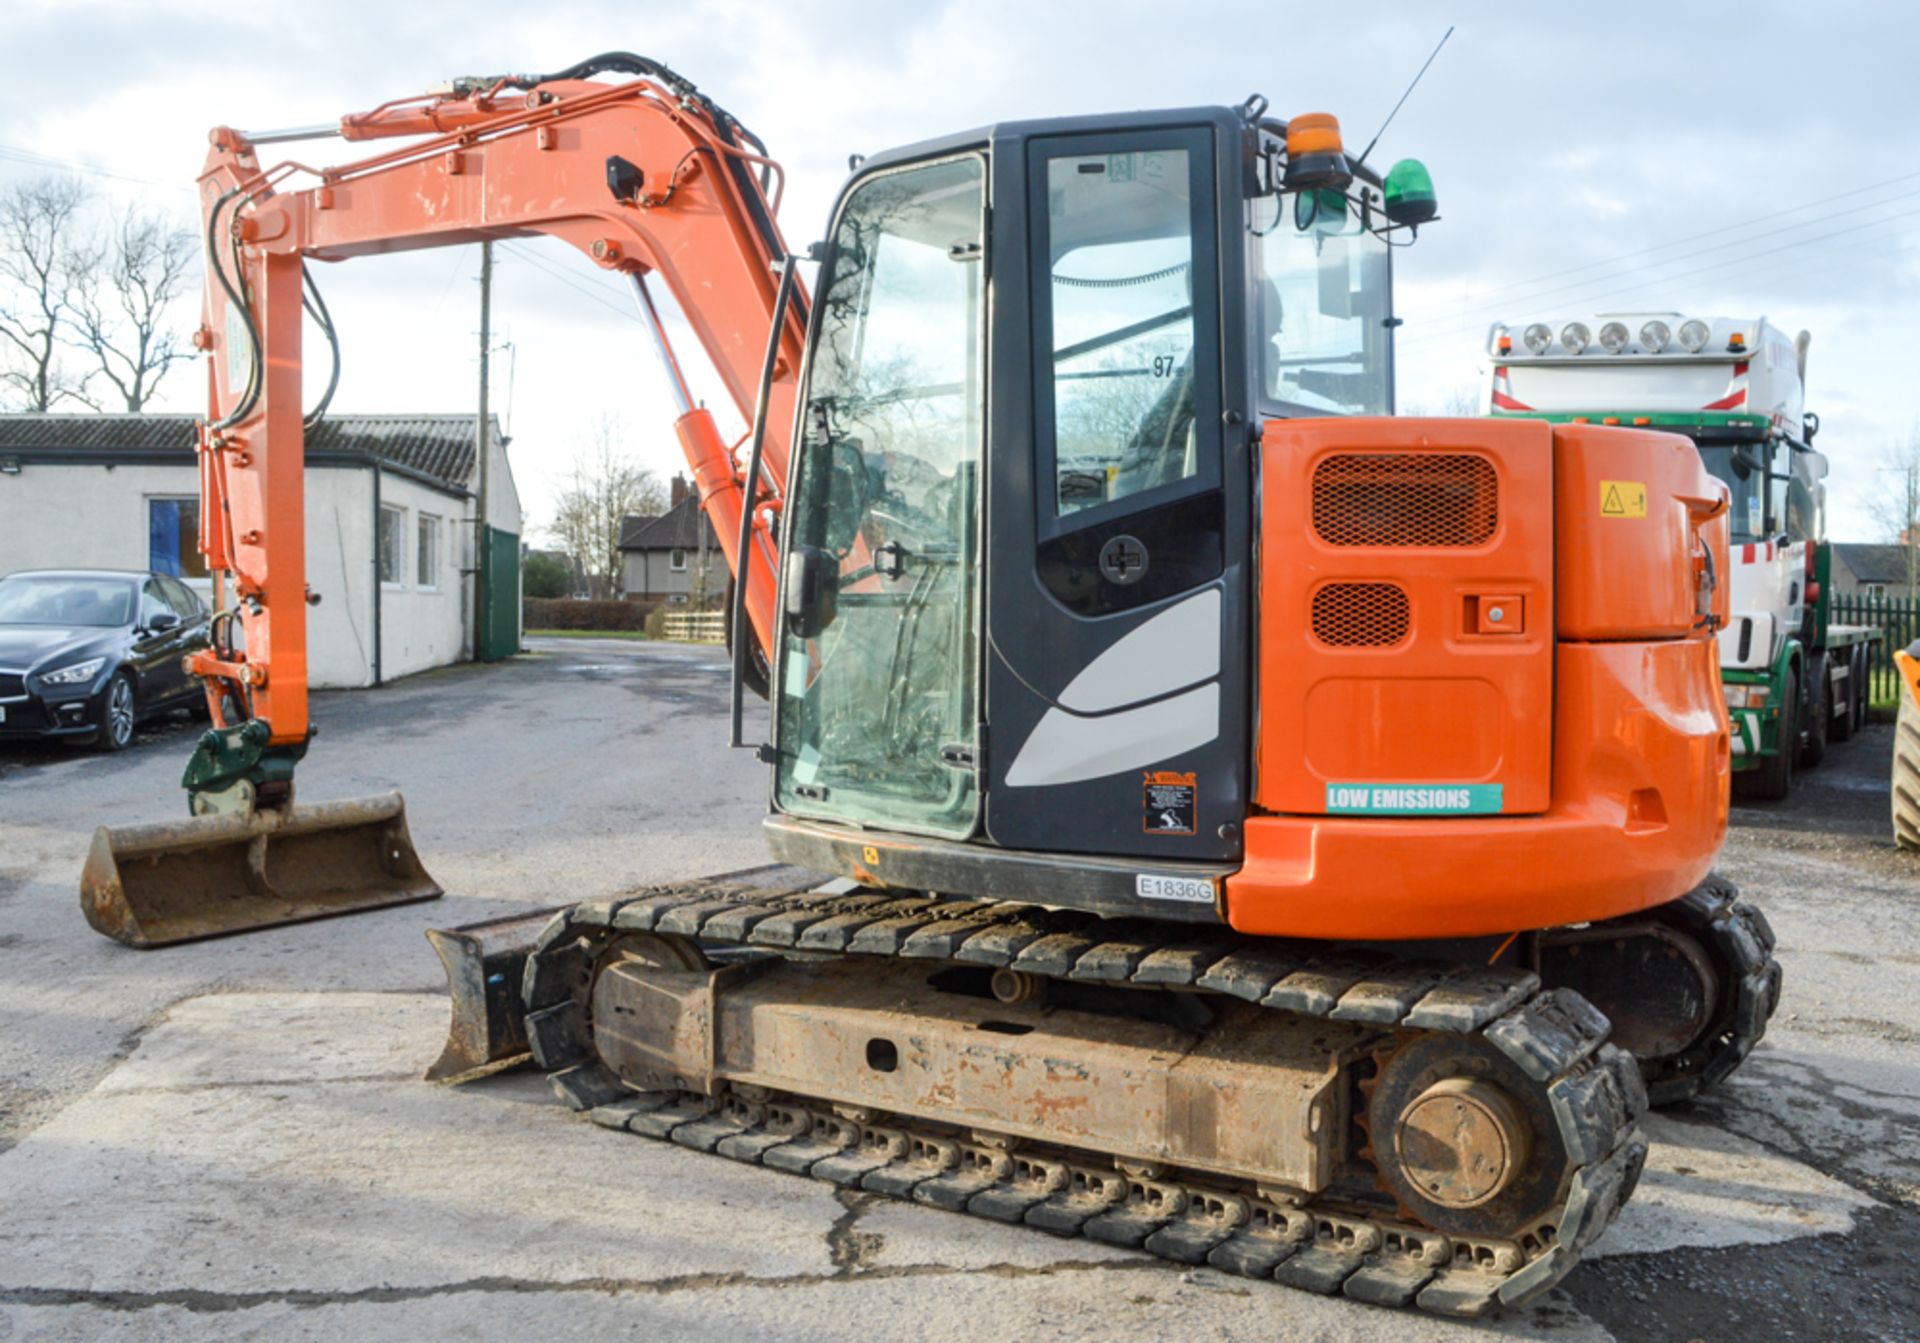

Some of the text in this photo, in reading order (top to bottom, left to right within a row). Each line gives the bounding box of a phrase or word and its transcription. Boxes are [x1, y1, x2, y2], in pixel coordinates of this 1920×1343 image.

[1154, 356, 1174, 378] 97
[1328, 788, 1470, 808] LOW EMISSIONS
[1140, 878, 1212, 899] E1836G
